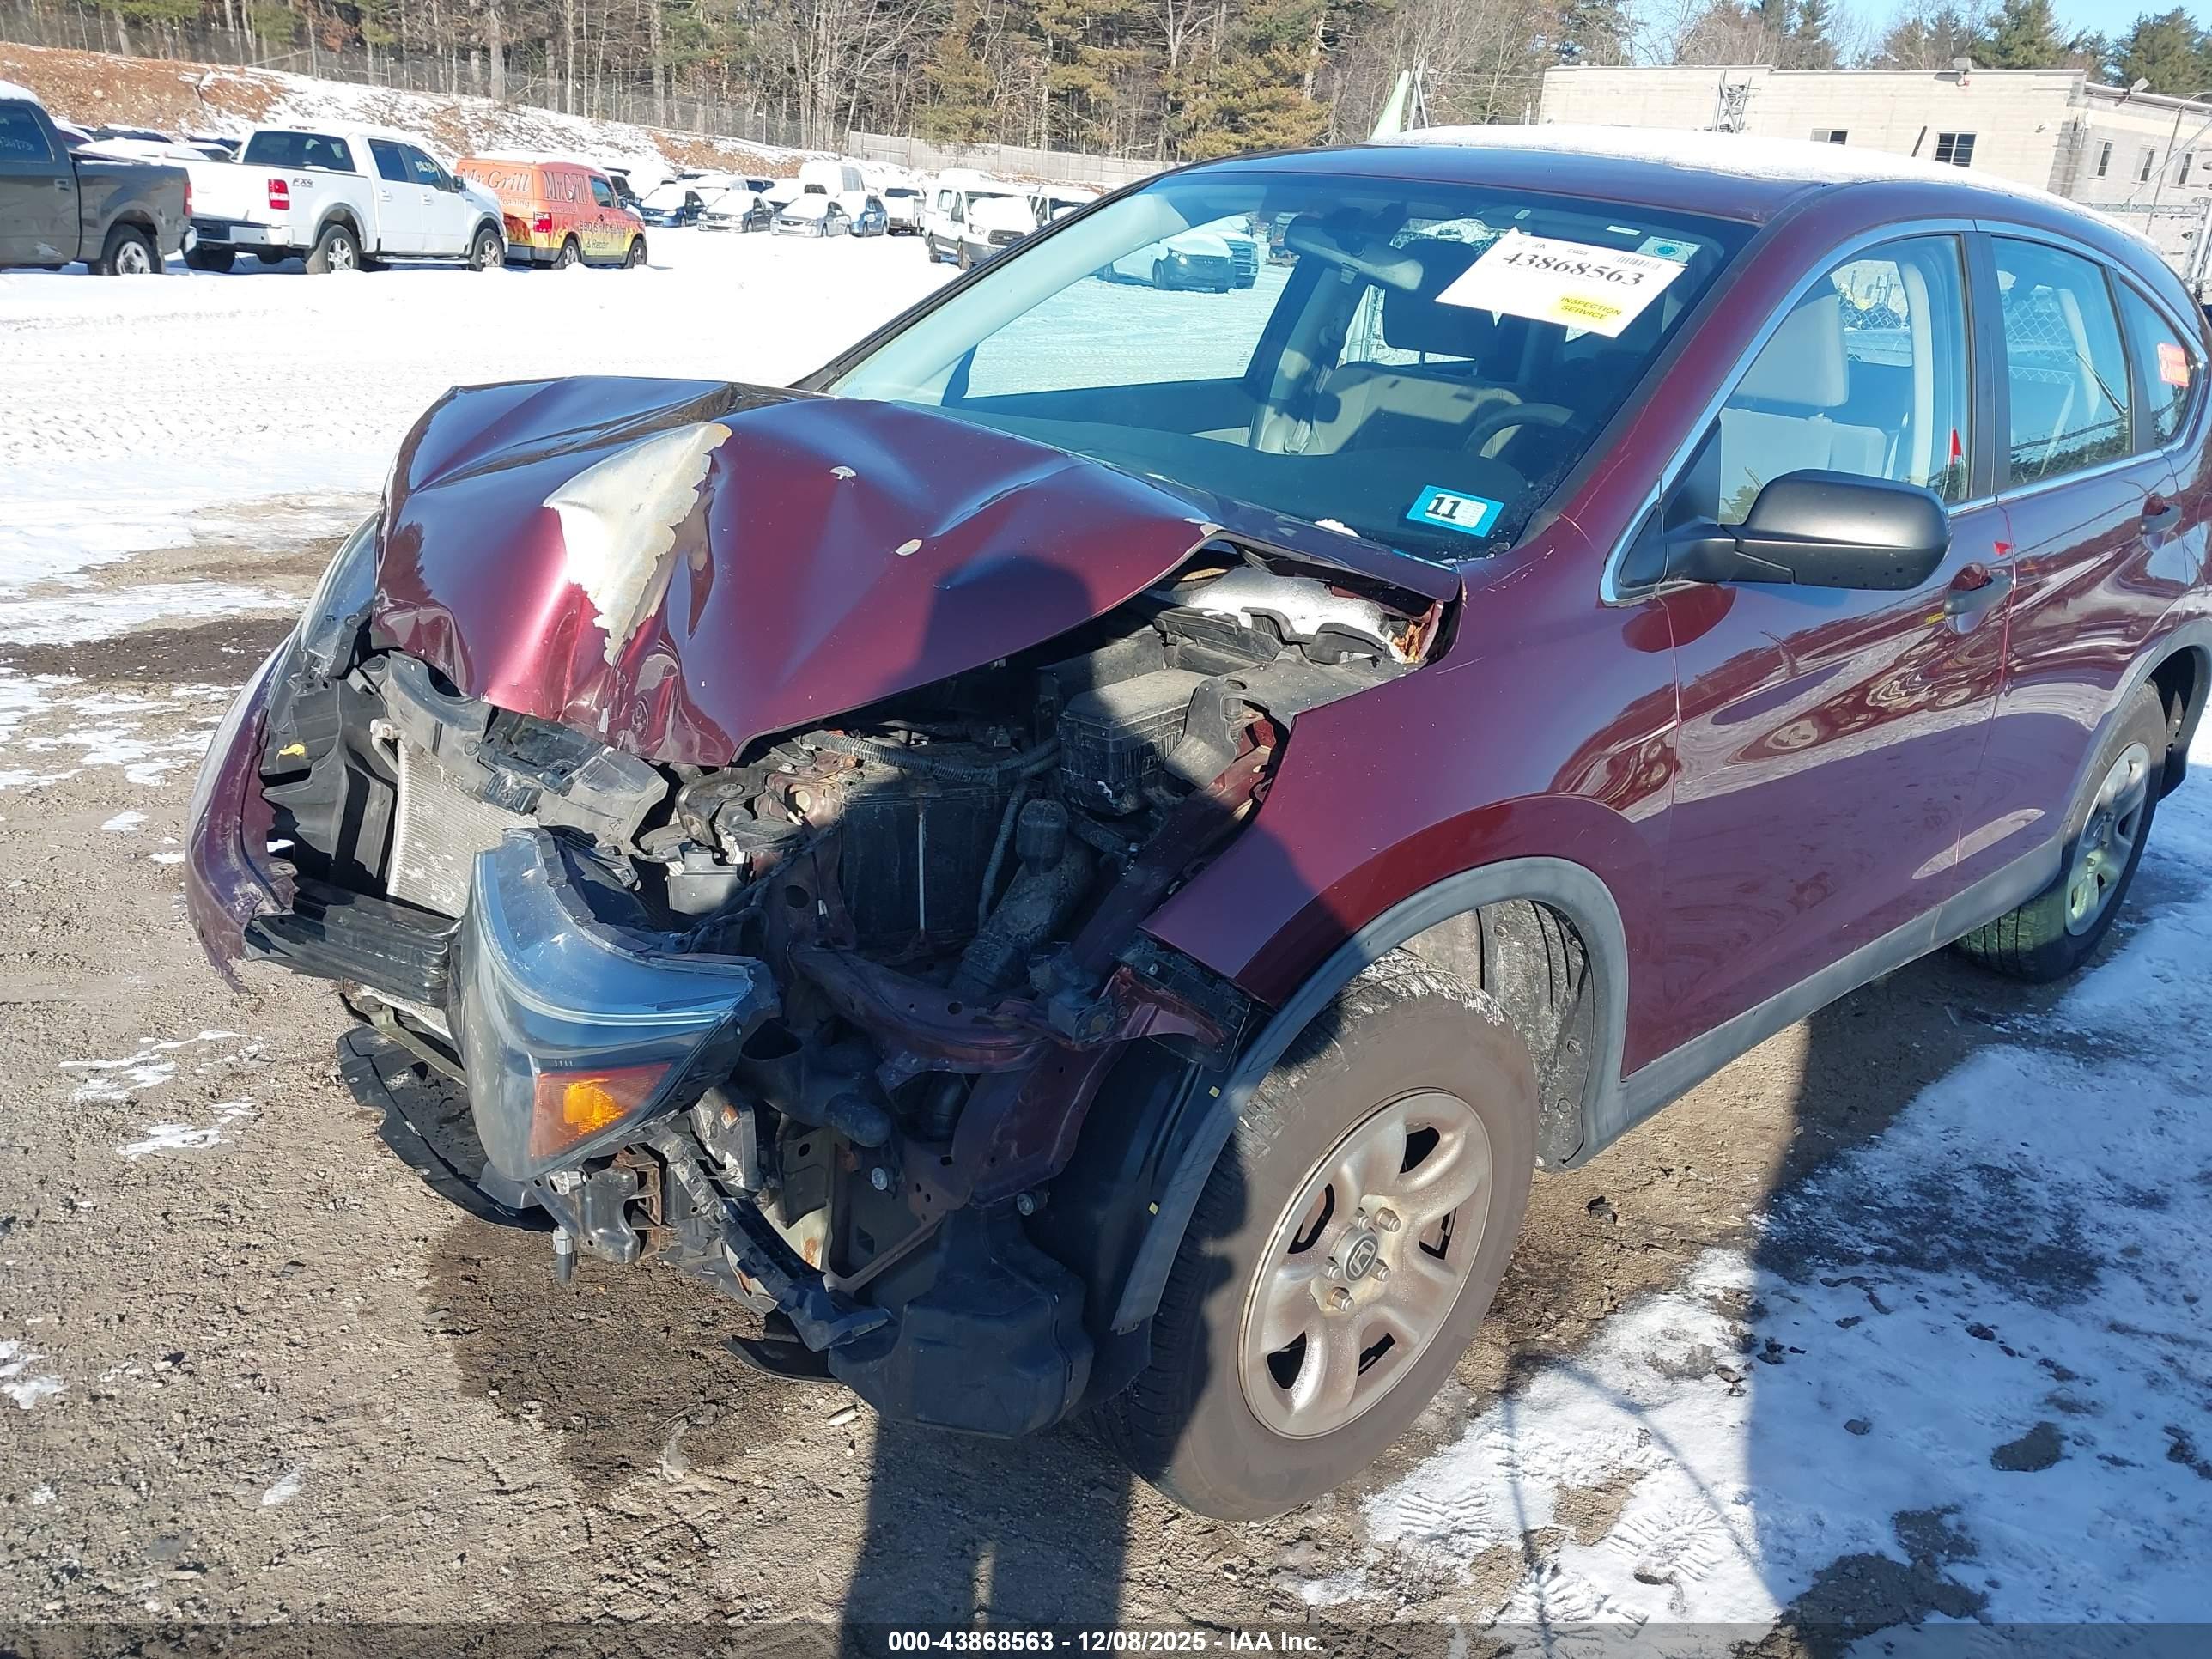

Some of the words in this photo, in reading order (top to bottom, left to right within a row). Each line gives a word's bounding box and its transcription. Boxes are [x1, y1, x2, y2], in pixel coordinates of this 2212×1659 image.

[488, 170, 530, 193] Grill
[498, 197, 530, 207] leaning
[1503, 252, 1644, 285] 43868563
[1560, 296, 1622, 315] INSPECTION
[1561, 305, 1607, 319] SERVICE
[1426, 497, 1462, 519] 11
